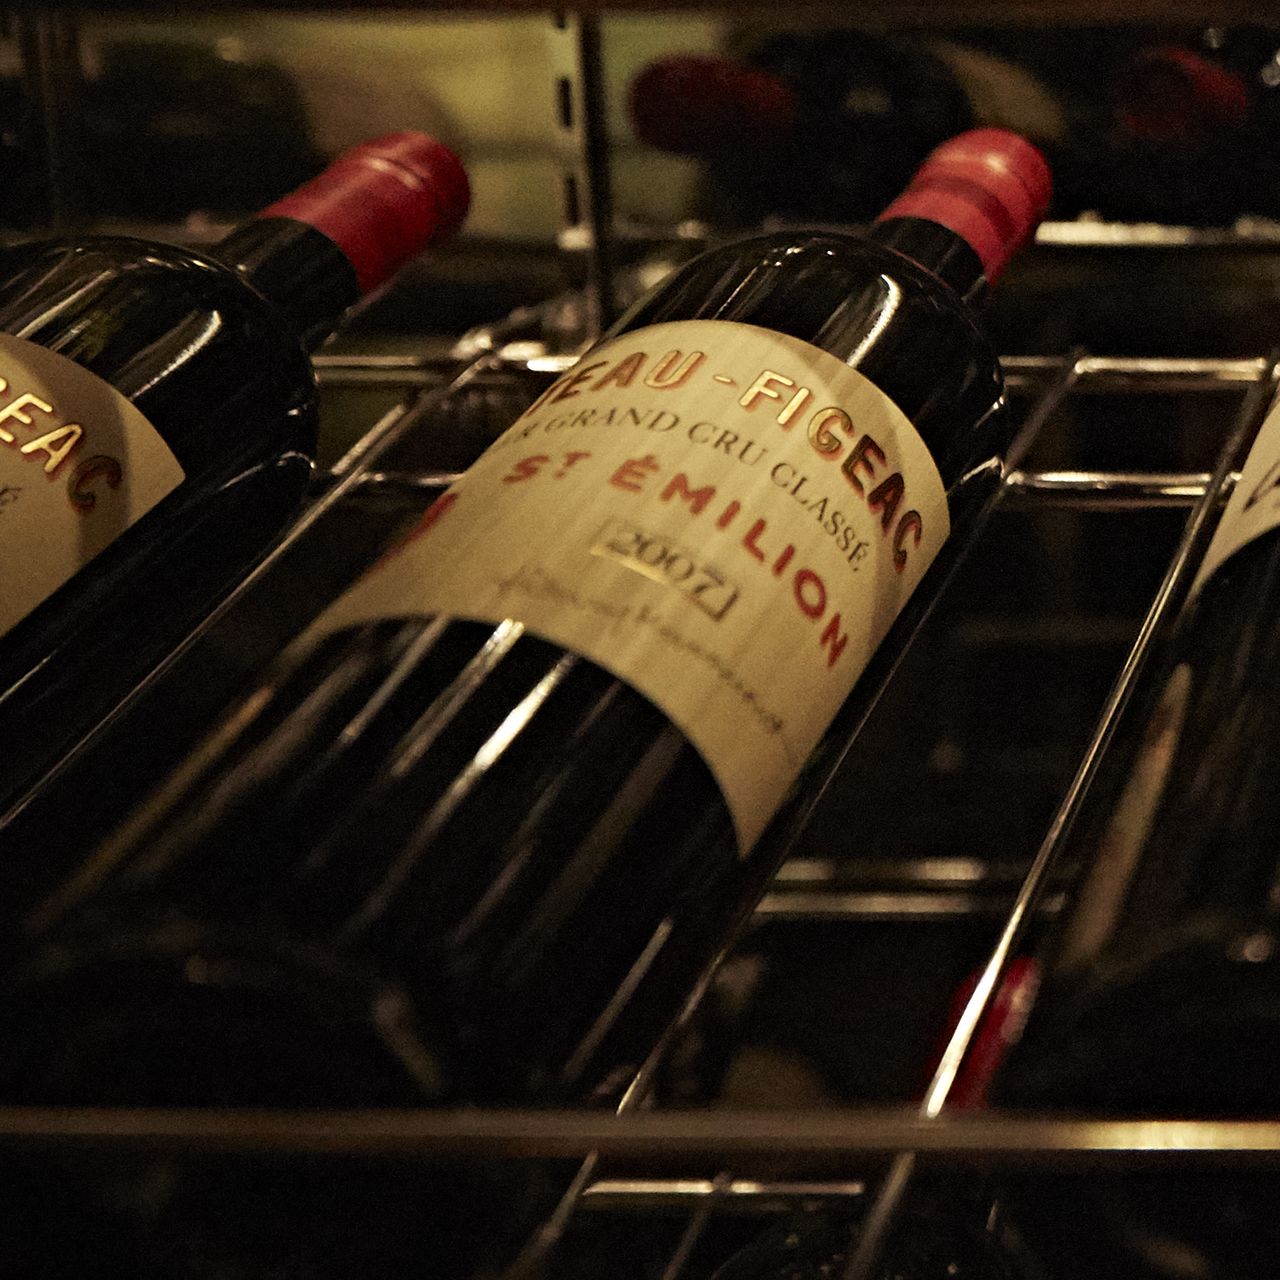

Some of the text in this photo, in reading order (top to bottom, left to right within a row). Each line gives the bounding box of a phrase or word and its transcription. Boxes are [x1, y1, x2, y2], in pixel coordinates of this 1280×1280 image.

[0, 377, 123, 514] EAC
[688, 422, 769, 466] CRU
[604, 531, 728, 600] 2007
[608, 453, 849, 668] ÉMILION
